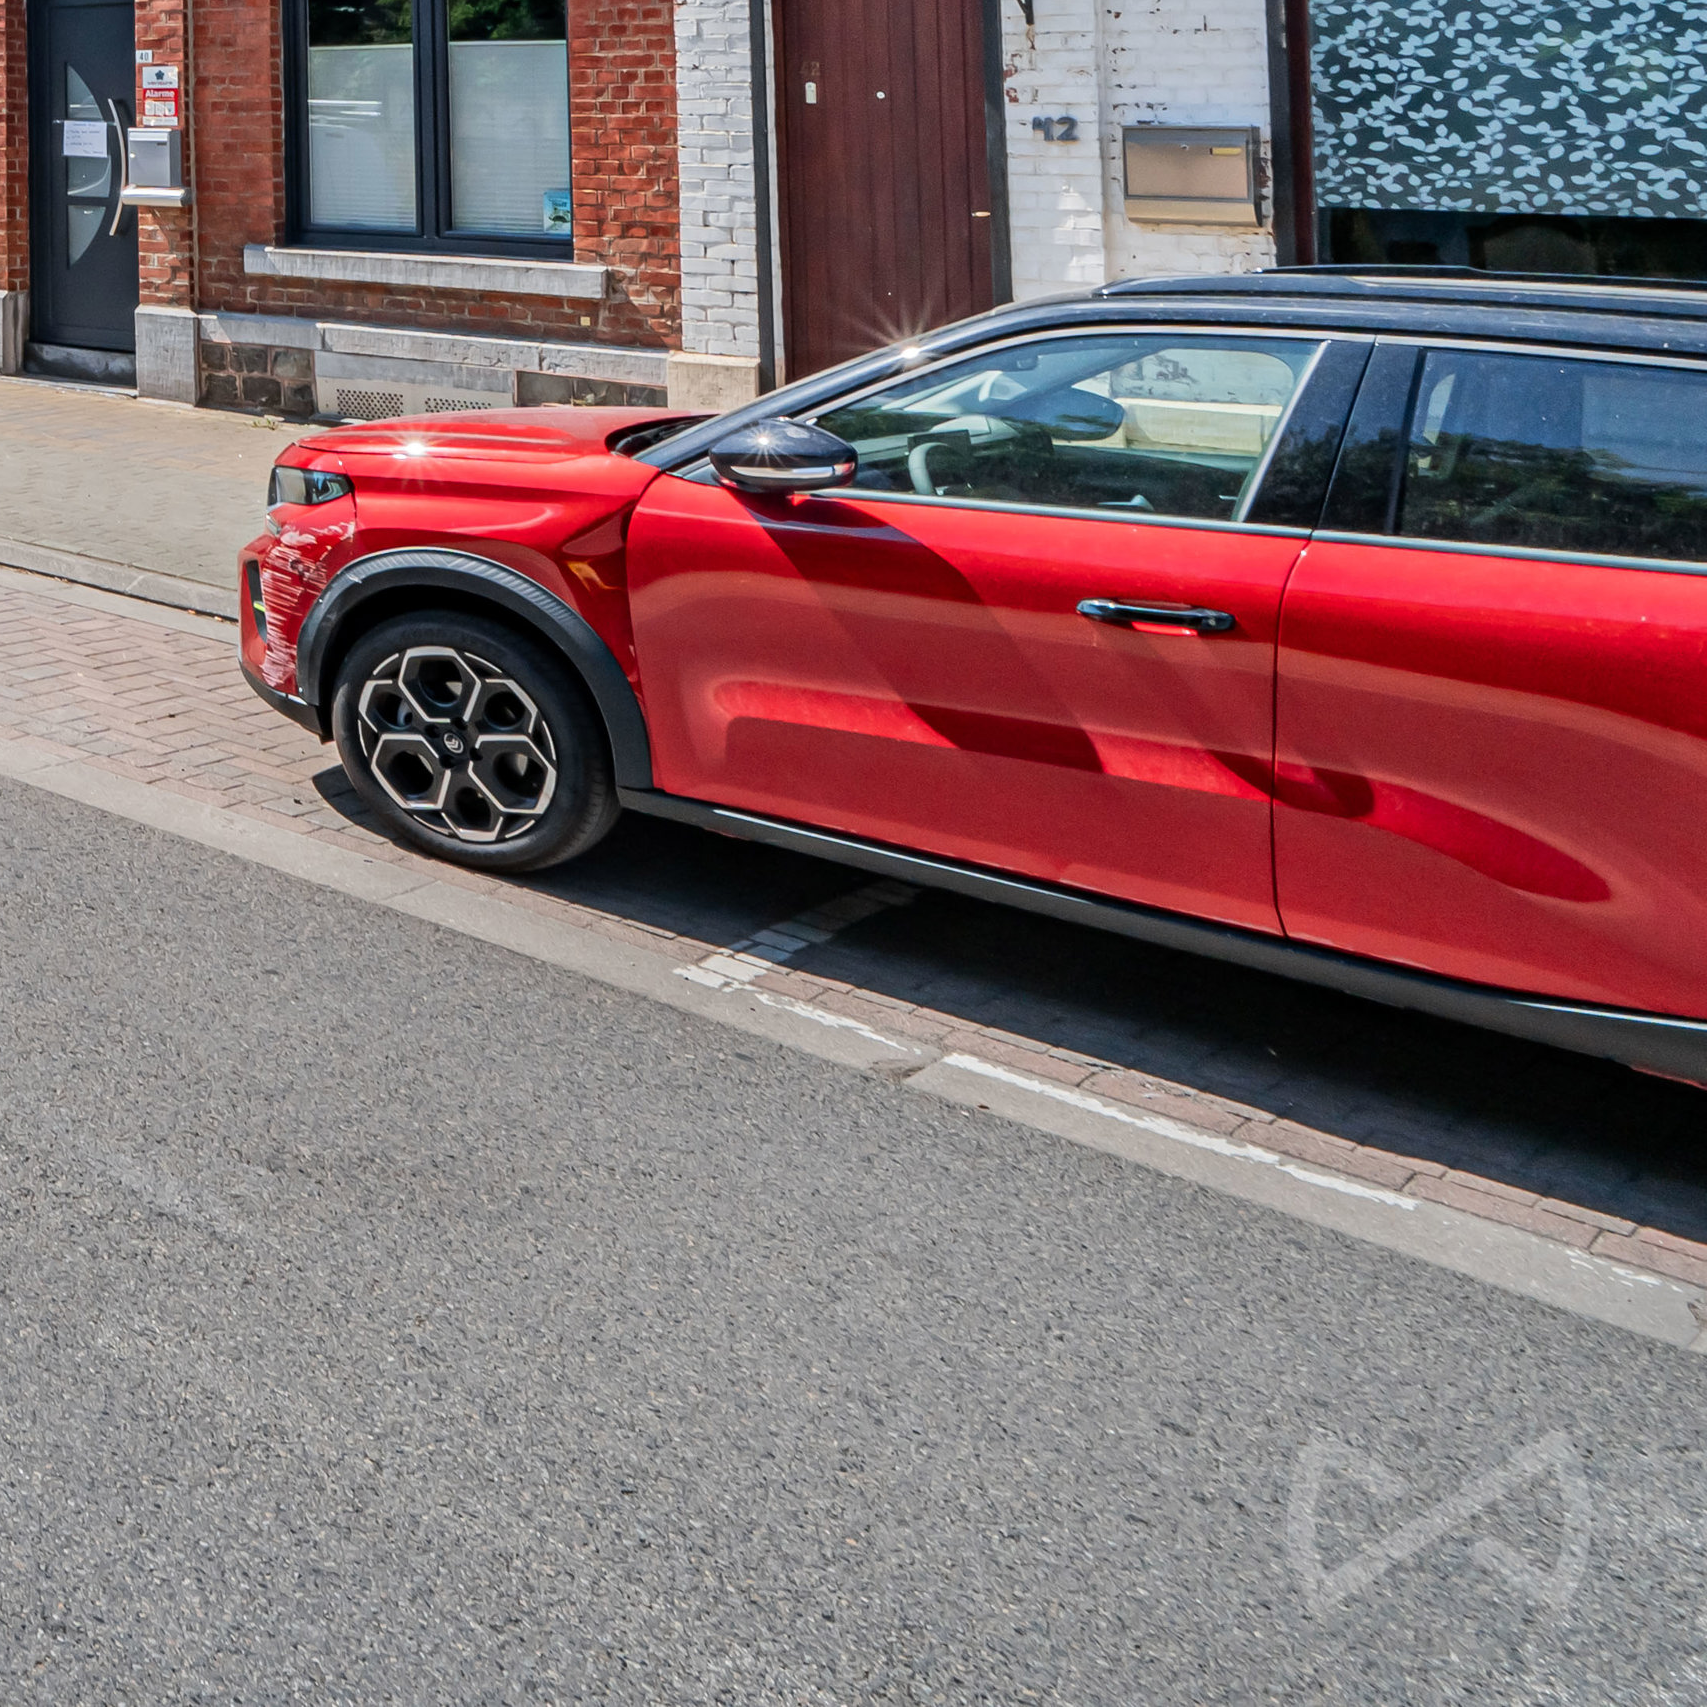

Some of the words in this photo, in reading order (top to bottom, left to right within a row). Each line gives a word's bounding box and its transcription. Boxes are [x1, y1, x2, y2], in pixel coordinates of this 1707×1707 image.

[139, 52, 149, 61] 40
[145, 89, 175, 98] Alarme
[1032, 116, 1080, 142] 42
